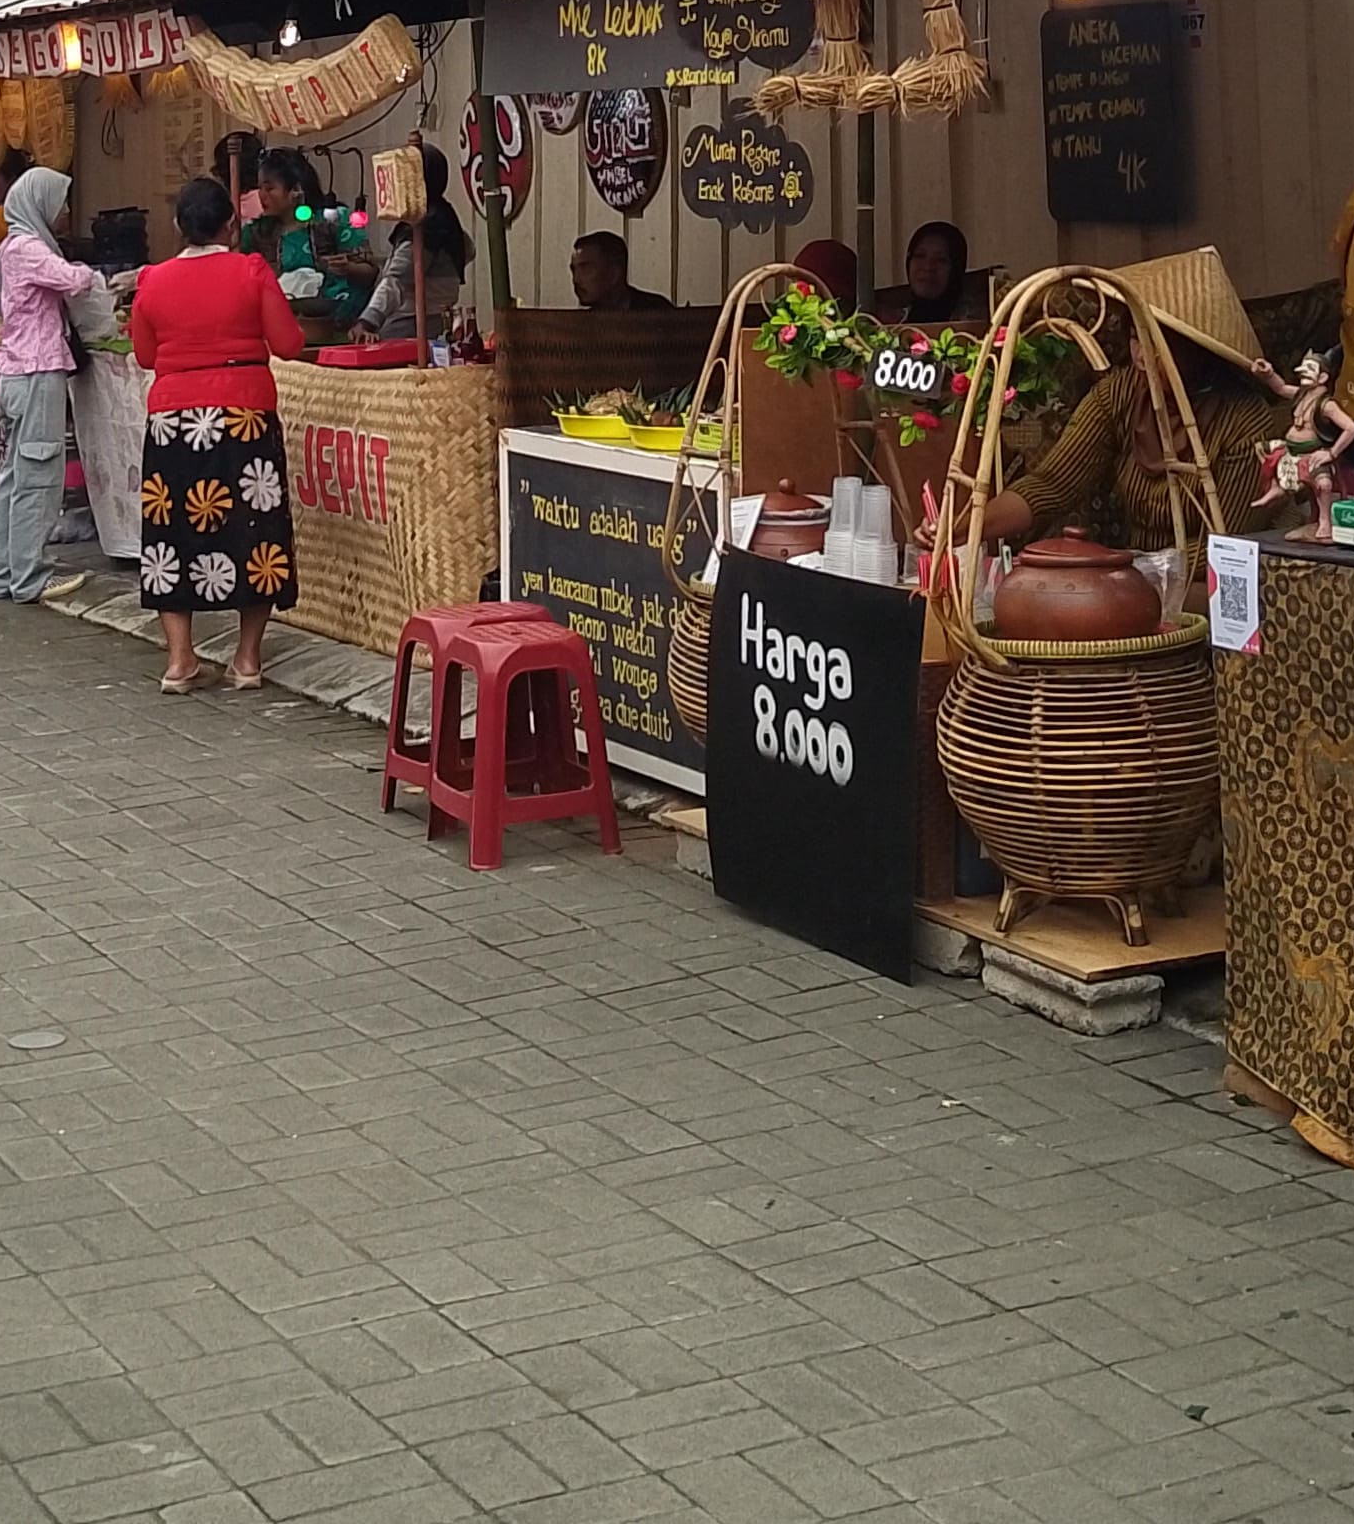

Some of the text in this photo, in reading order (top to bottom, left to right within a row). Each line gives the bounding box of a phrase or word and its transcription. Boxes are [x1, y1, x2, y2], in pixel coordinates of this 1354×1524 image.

[1069, 20, 1120, 47] ANEKA
[586, 42, 607, 76] 8K
[1118, 149, 1147, 194] 4K
[874, 349, 936, 391] 8.000
[295, 423, 389, 525] JEPIT
[590, 505, 638, 544] adalah
[739, 591, 854, 711] Harga
[752, 683, 855, 788] 8.000
